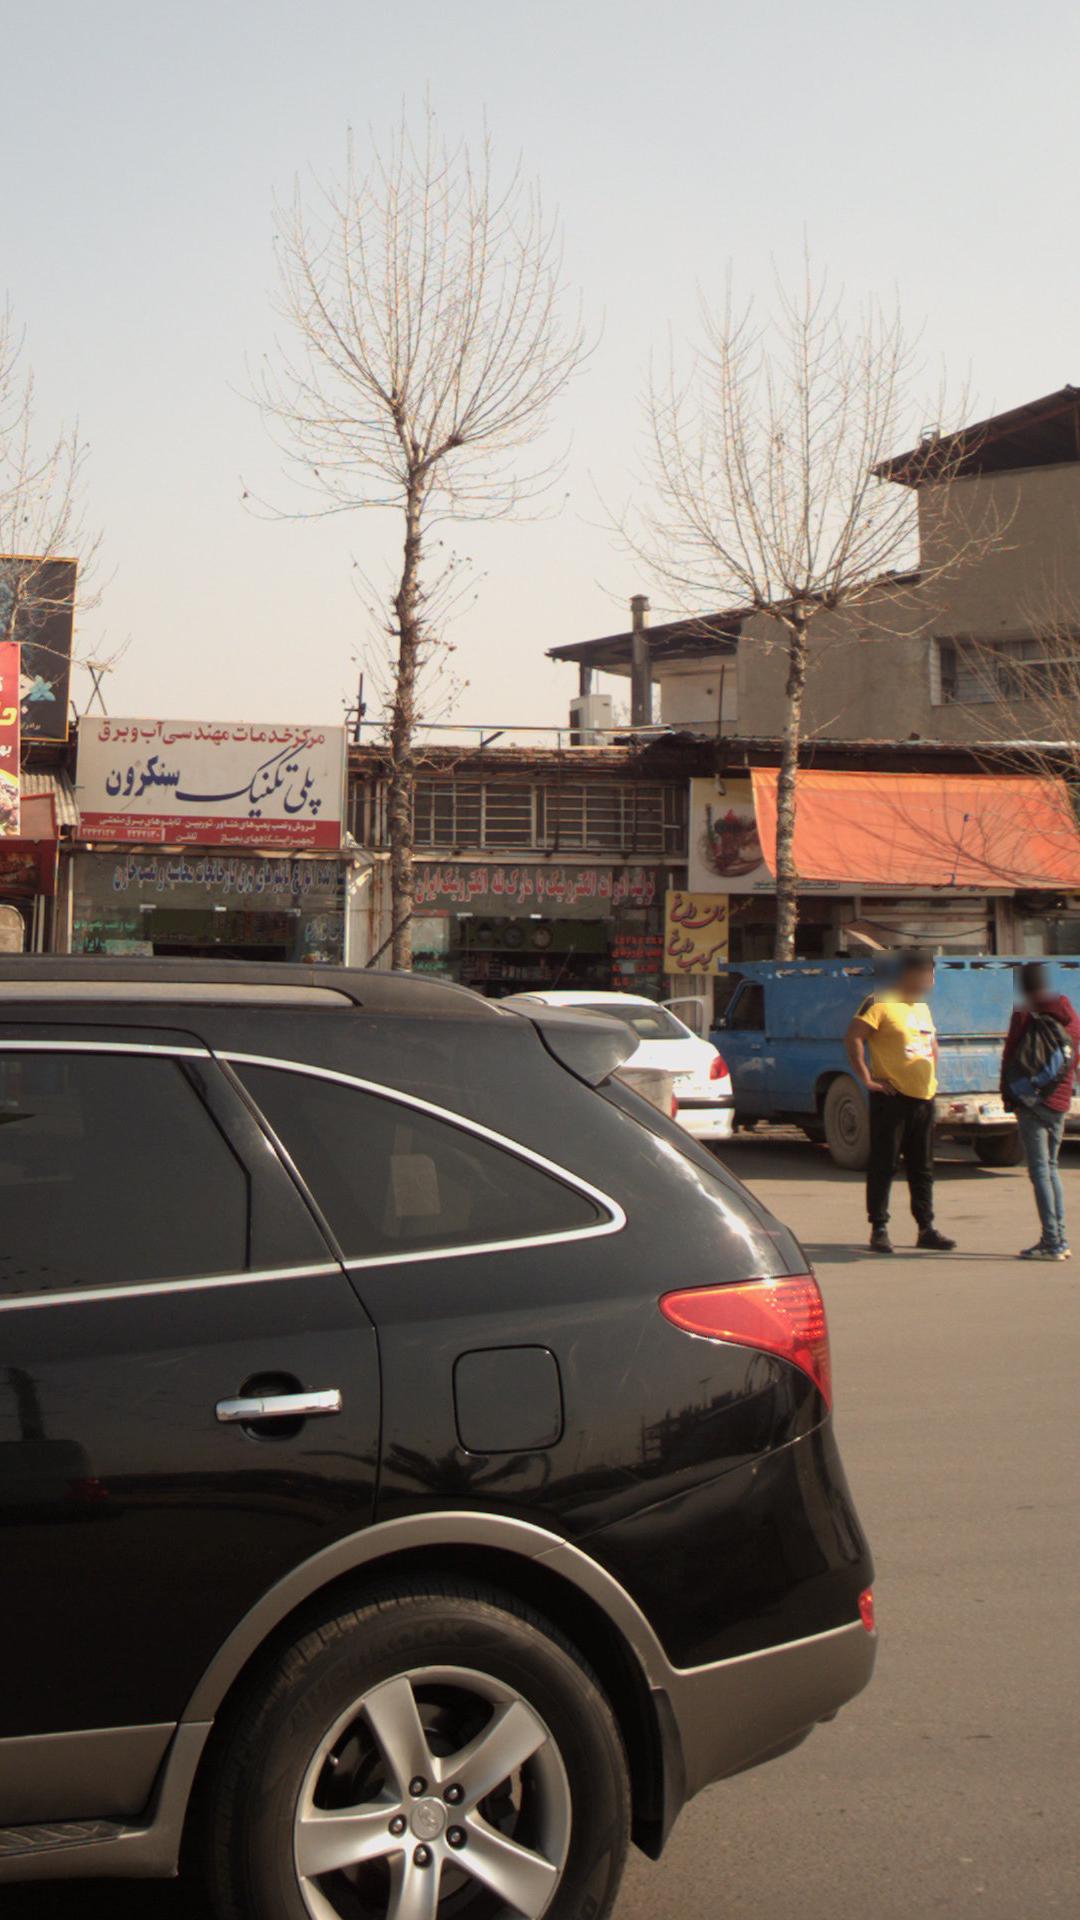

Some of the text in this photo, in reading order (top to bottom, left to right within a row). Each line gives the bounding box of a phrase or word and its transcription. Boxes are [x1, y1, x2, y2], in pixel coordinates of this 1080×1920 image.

[98, 721, 325, 749] مرکز خدمات مهندسی آب و برق
[175, 741, 310, 818] تکنیک
[284, 766, 322, 815] پلی
[175, 831, 198, 843] تلفن
[669, 892, 697, 922] داغ
[680, 905, 726, 929] نان
[666, 928, 695, 957] داغ
[676, 939, 729, 973] کباب
